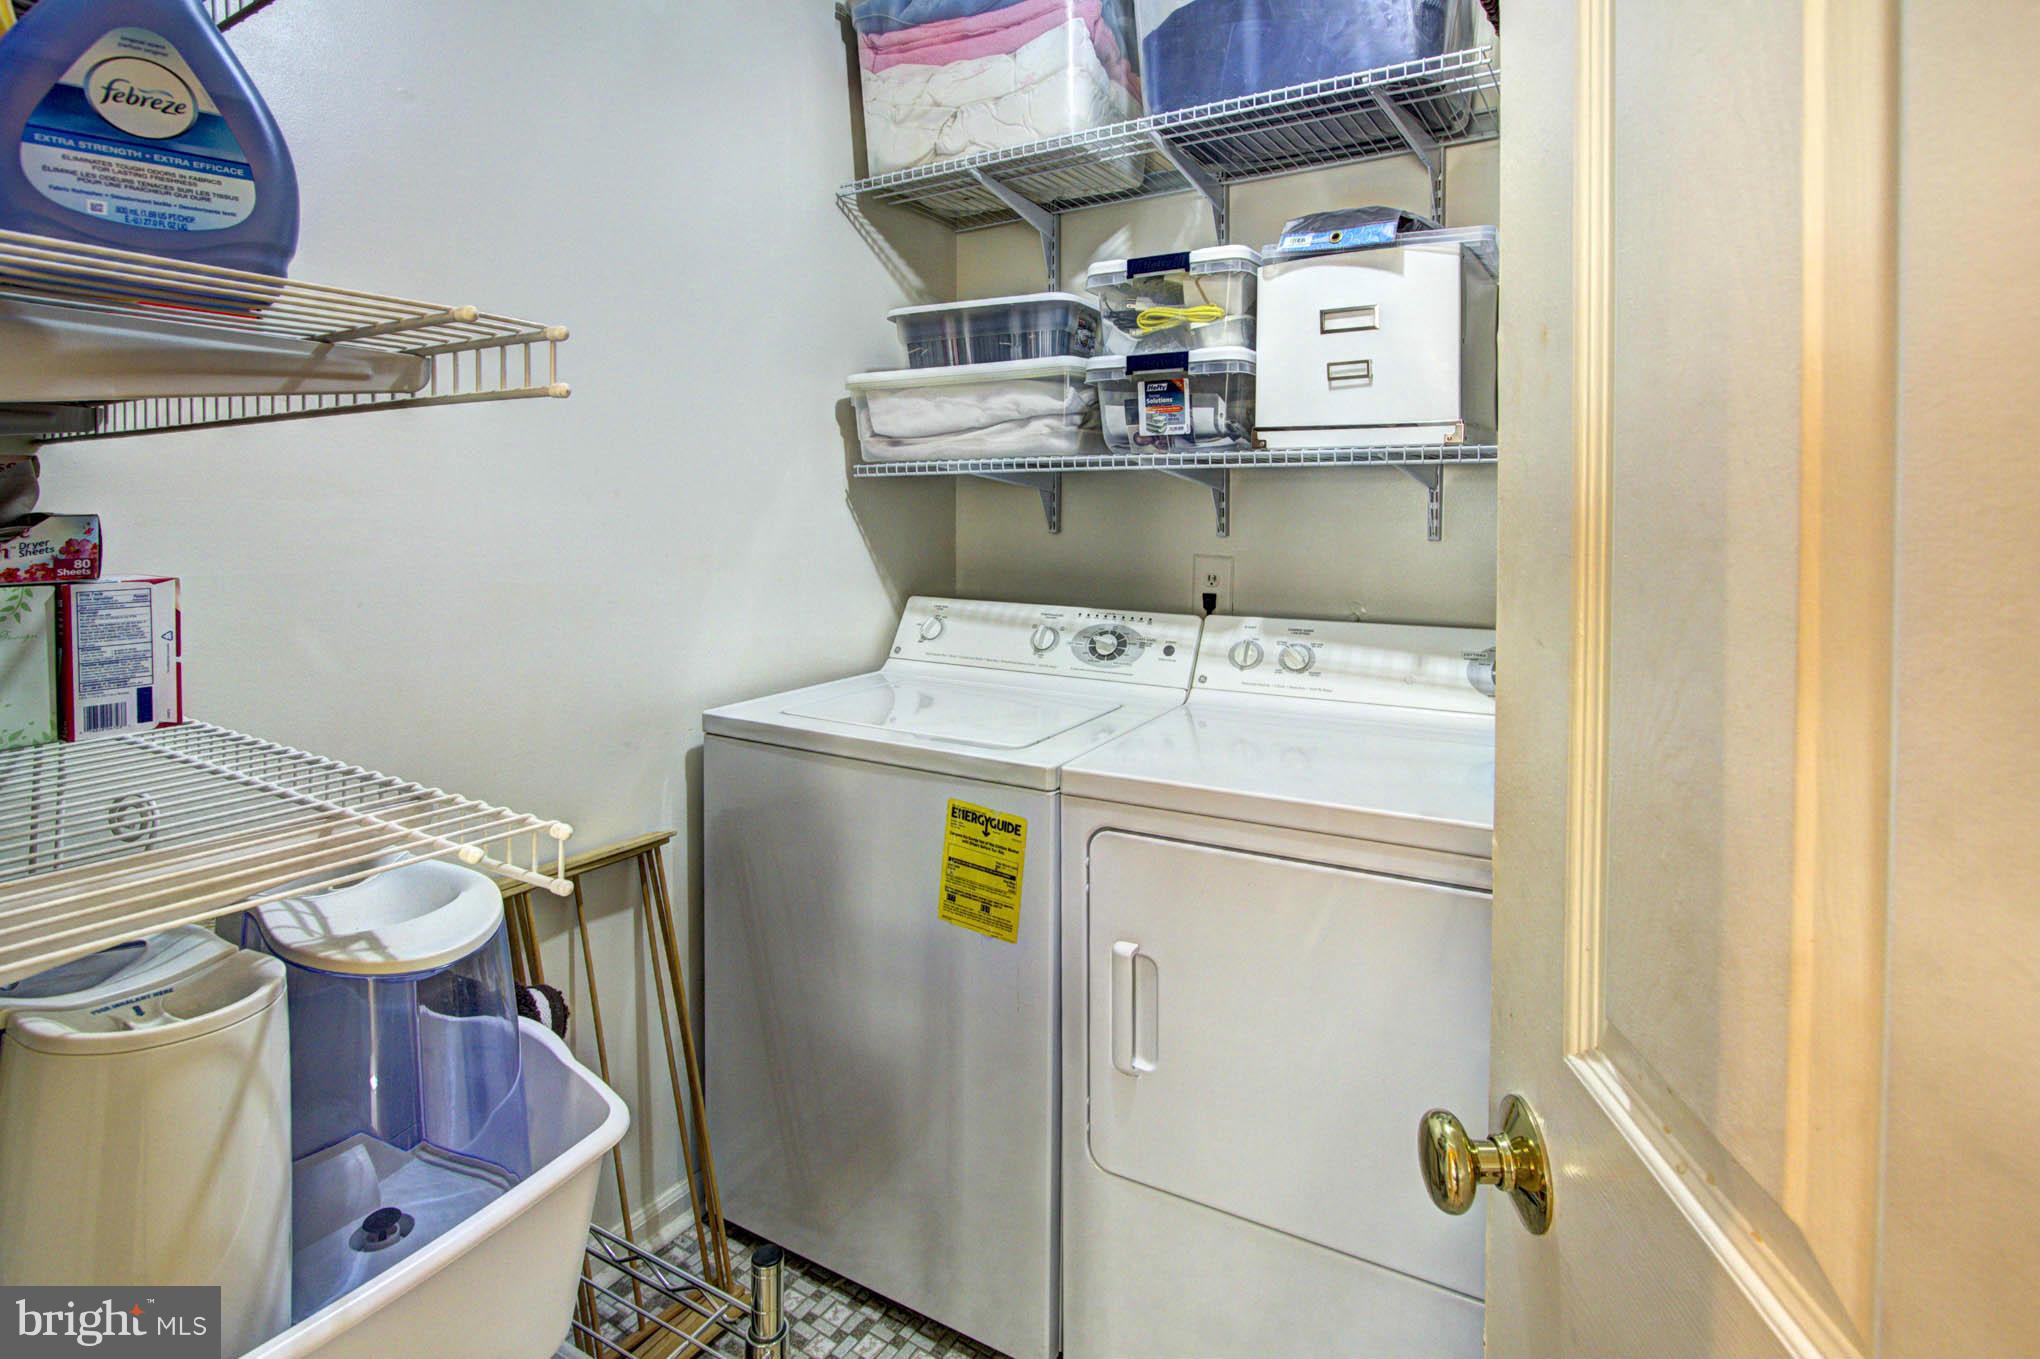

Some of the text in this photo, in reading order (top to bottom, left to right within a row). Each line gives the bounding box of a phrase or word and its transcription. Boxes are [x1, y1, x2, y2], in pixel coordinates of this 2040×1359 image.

[101, 78, 186, 115] febreze
[33, 132, 245, 176] EXTRA STRENGTH EXTRA EFFICACE
[91, 164, 199, 188] FOR LASTING FRESHNESS
[115, 161, 145, 173] TOUGH
[147, 167, 177, 179] ODORS
[188, 175, 223, 186] FABRICS
[18, 539, 51, 551] Dryer
[18, 546, 55, 558] Sheets
[56, 568, 92, 577] Sheets
[73, 559, 91, 569] 80
[951, 806, 1022, 837] ENERGYGUIDE
